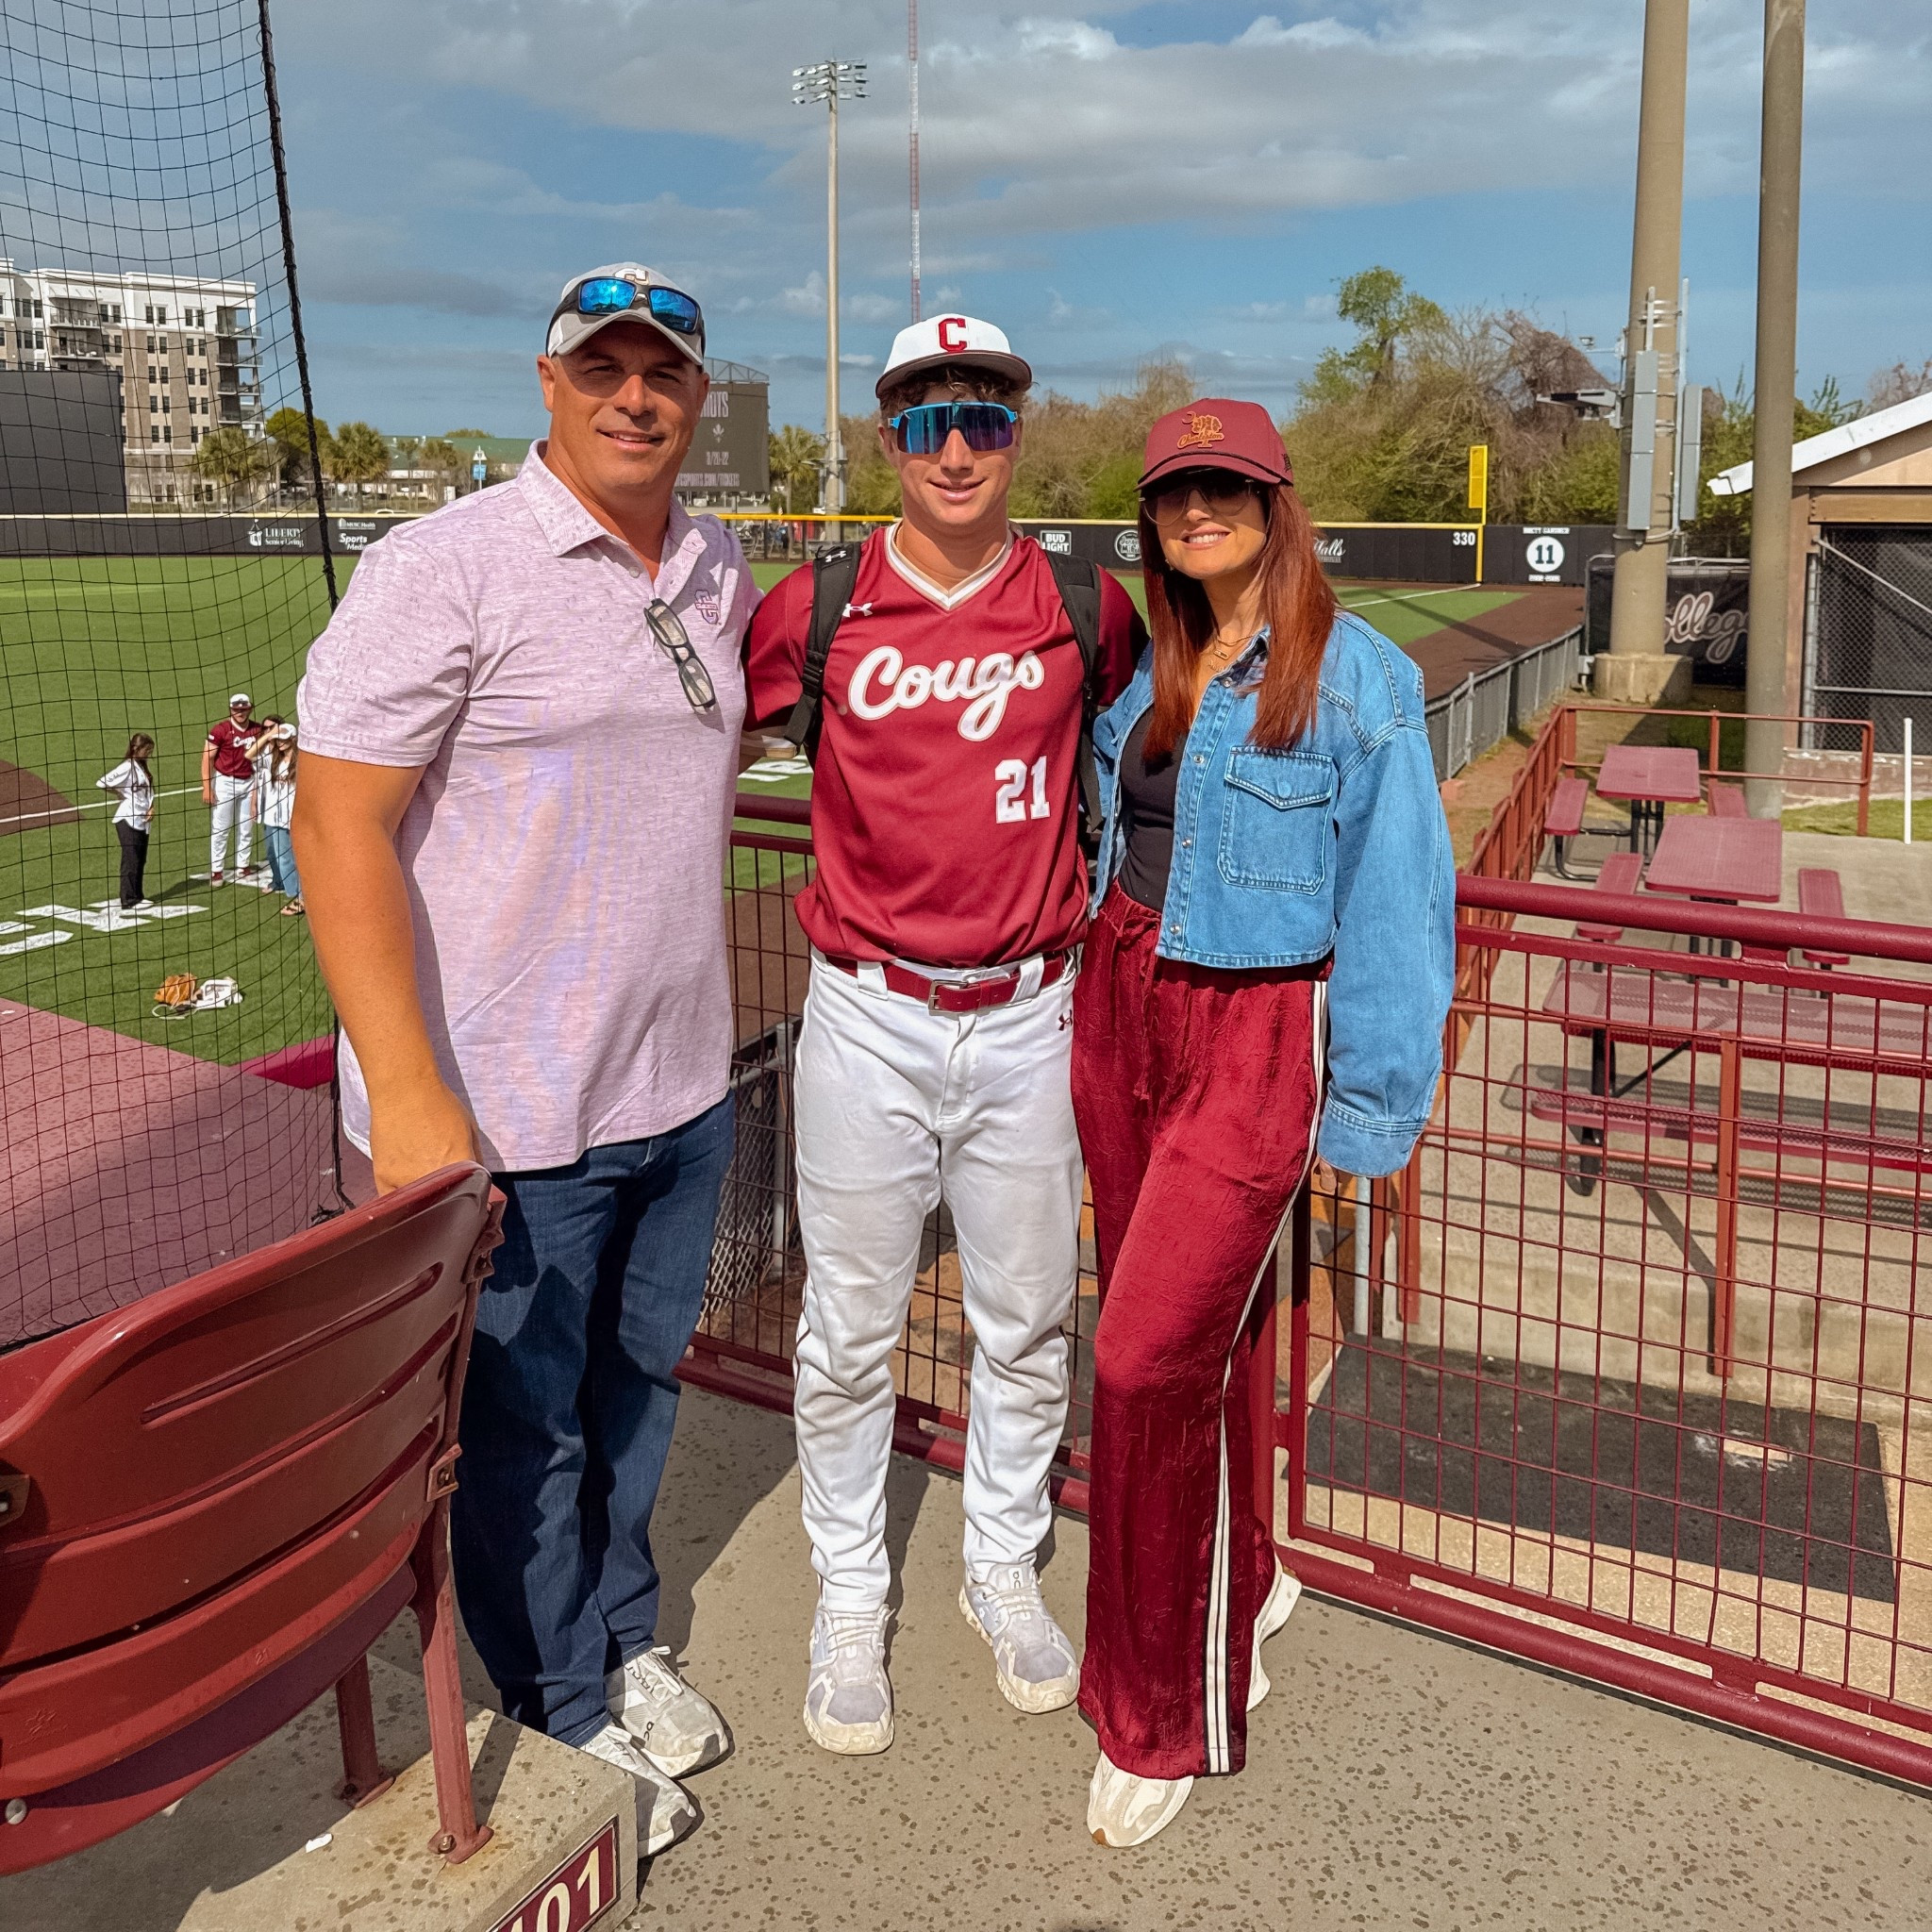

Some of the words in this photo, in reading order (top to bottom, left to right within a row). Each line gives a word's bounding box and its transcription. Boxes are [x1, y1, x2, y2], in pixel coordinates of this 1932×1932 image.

[939, 317, 967, 353] C
[339, 532, 368, 545] Sports
[1041, 542, 1070, 552] LIGHT
[1045, 533, 1066, 543] BUD
[1453, 531, 1476, 545] 330
[1535, 544, 1556, 564] 11
[1664, 591, 1749, 664] lleg
[849, 645, 1044, 741] Cougs
[994, 755, 1051, 824] 21
[510, 1845, 600, 1932] 01
